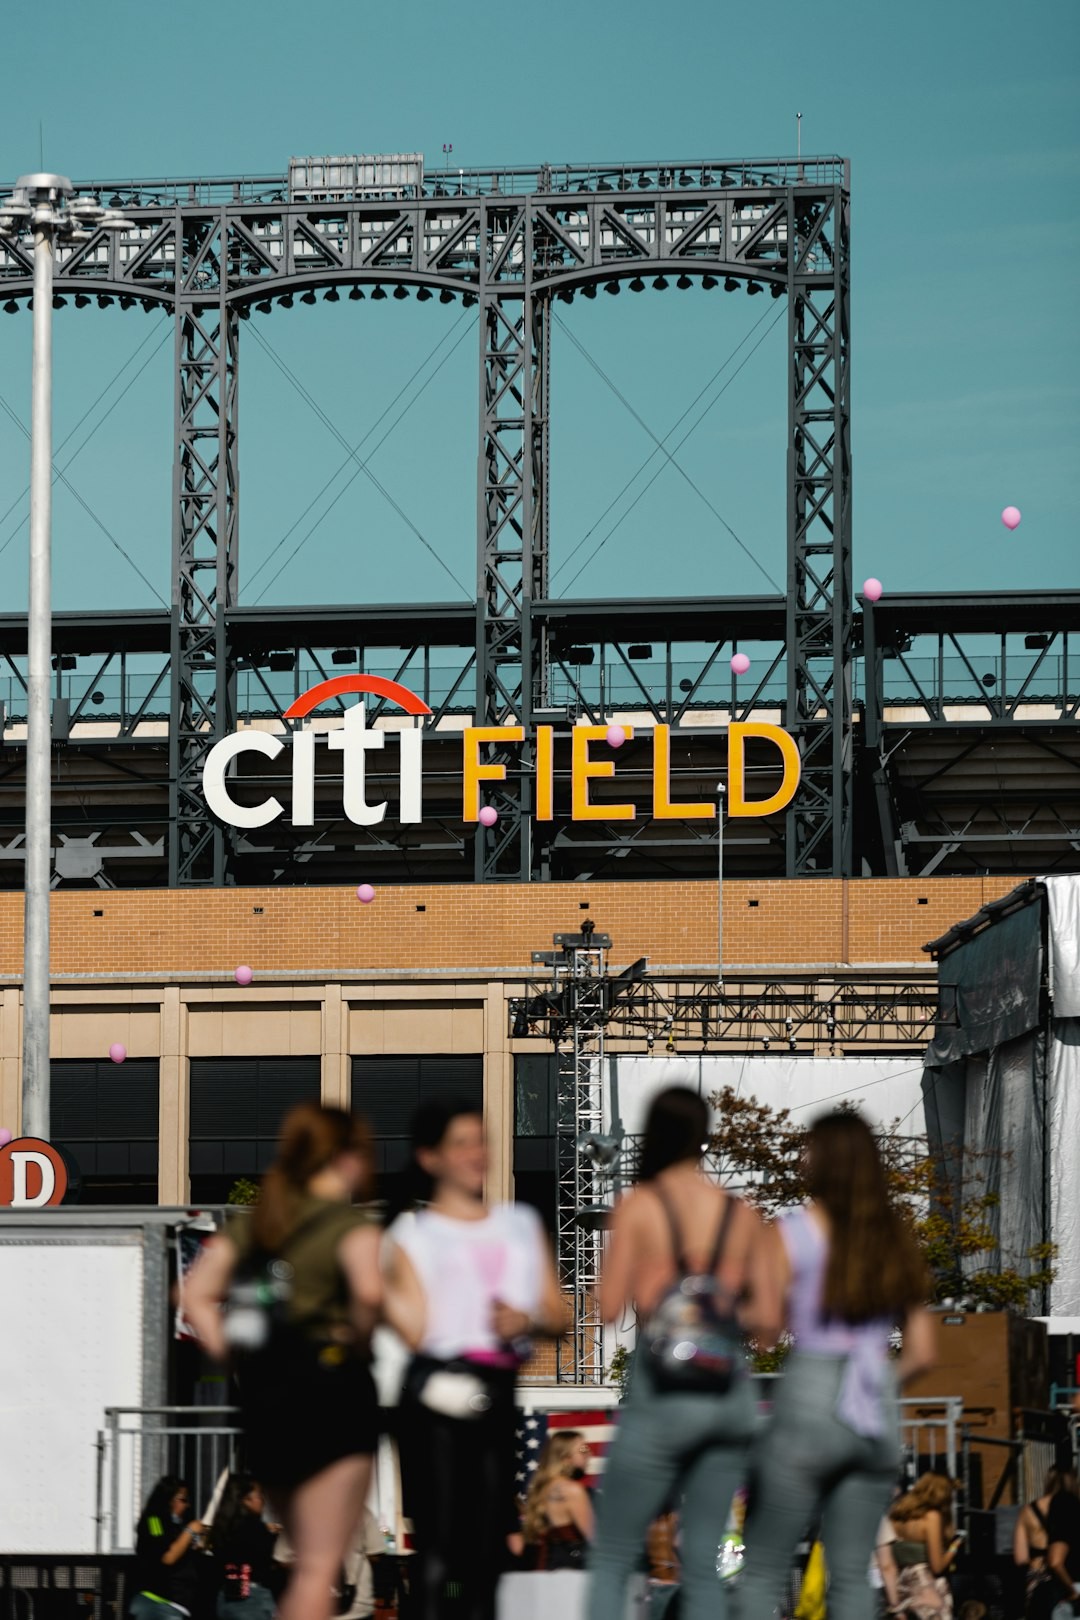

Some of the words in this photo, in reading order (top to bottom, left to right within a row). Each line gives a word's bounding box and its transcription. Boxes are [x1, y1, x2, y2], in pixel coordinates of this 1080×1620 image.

[202, 701, 423, 828] citi
[462, 722, 801, 822] FIELD
[10, 1151, 56, 1208] D
